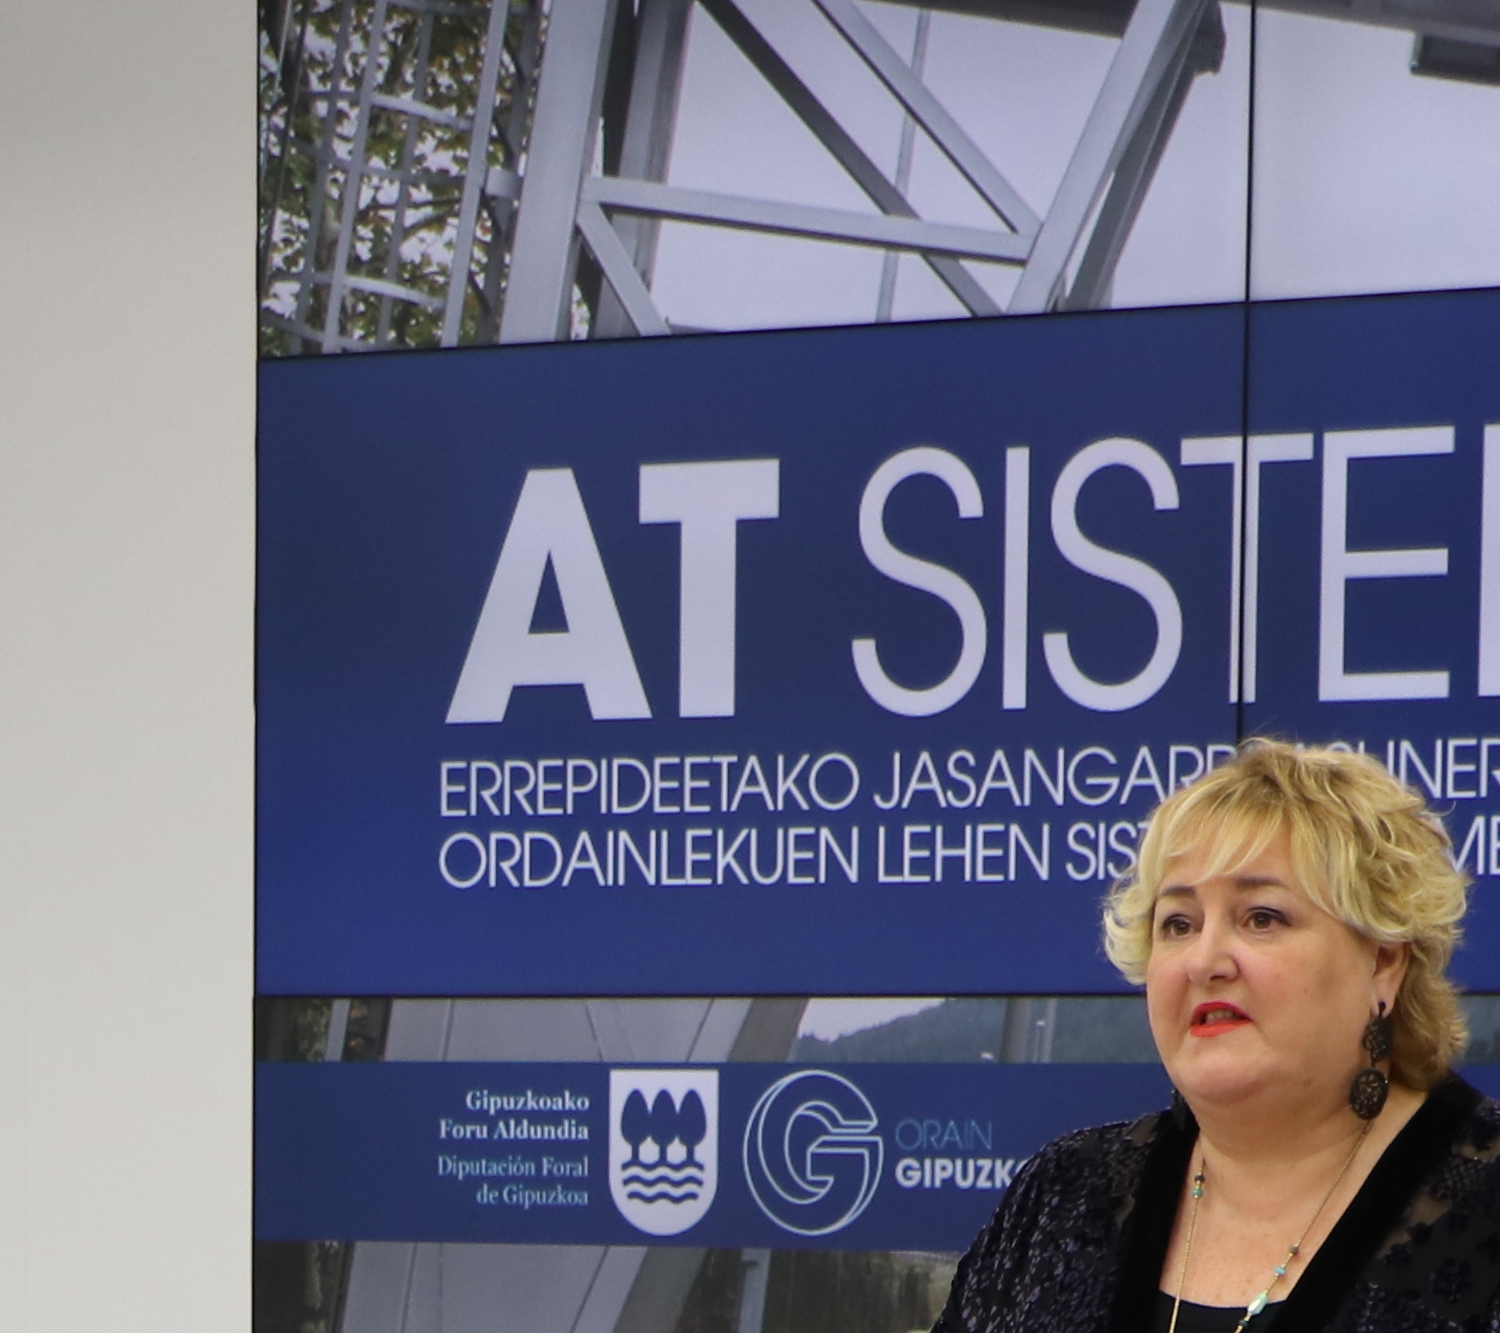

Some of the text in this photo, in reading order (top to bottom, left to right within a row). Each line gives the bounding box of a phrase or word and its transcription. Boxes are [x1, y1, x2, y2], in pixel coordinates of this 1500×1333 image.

[445, 459, 780, 725] AT
[440, 752, 861, 817] ERREPIDEETAKO
[438, 827, 860, 889] ORDAINLEKUEN
[878, 823, 1050, 883] LEHEN
[465, 1089, 590, 1116] Gipuzkoako
[440, 1119, 589, 1140] Foru Aldundia
[895, 1119, 992, 1151] ORAIN
[438, 1155, 589, 1180] Diputación Foral
[895, 1157, 1028, 1189] GIPUZK
[476, 1183, 589, 1209] de Gipuzkoa
